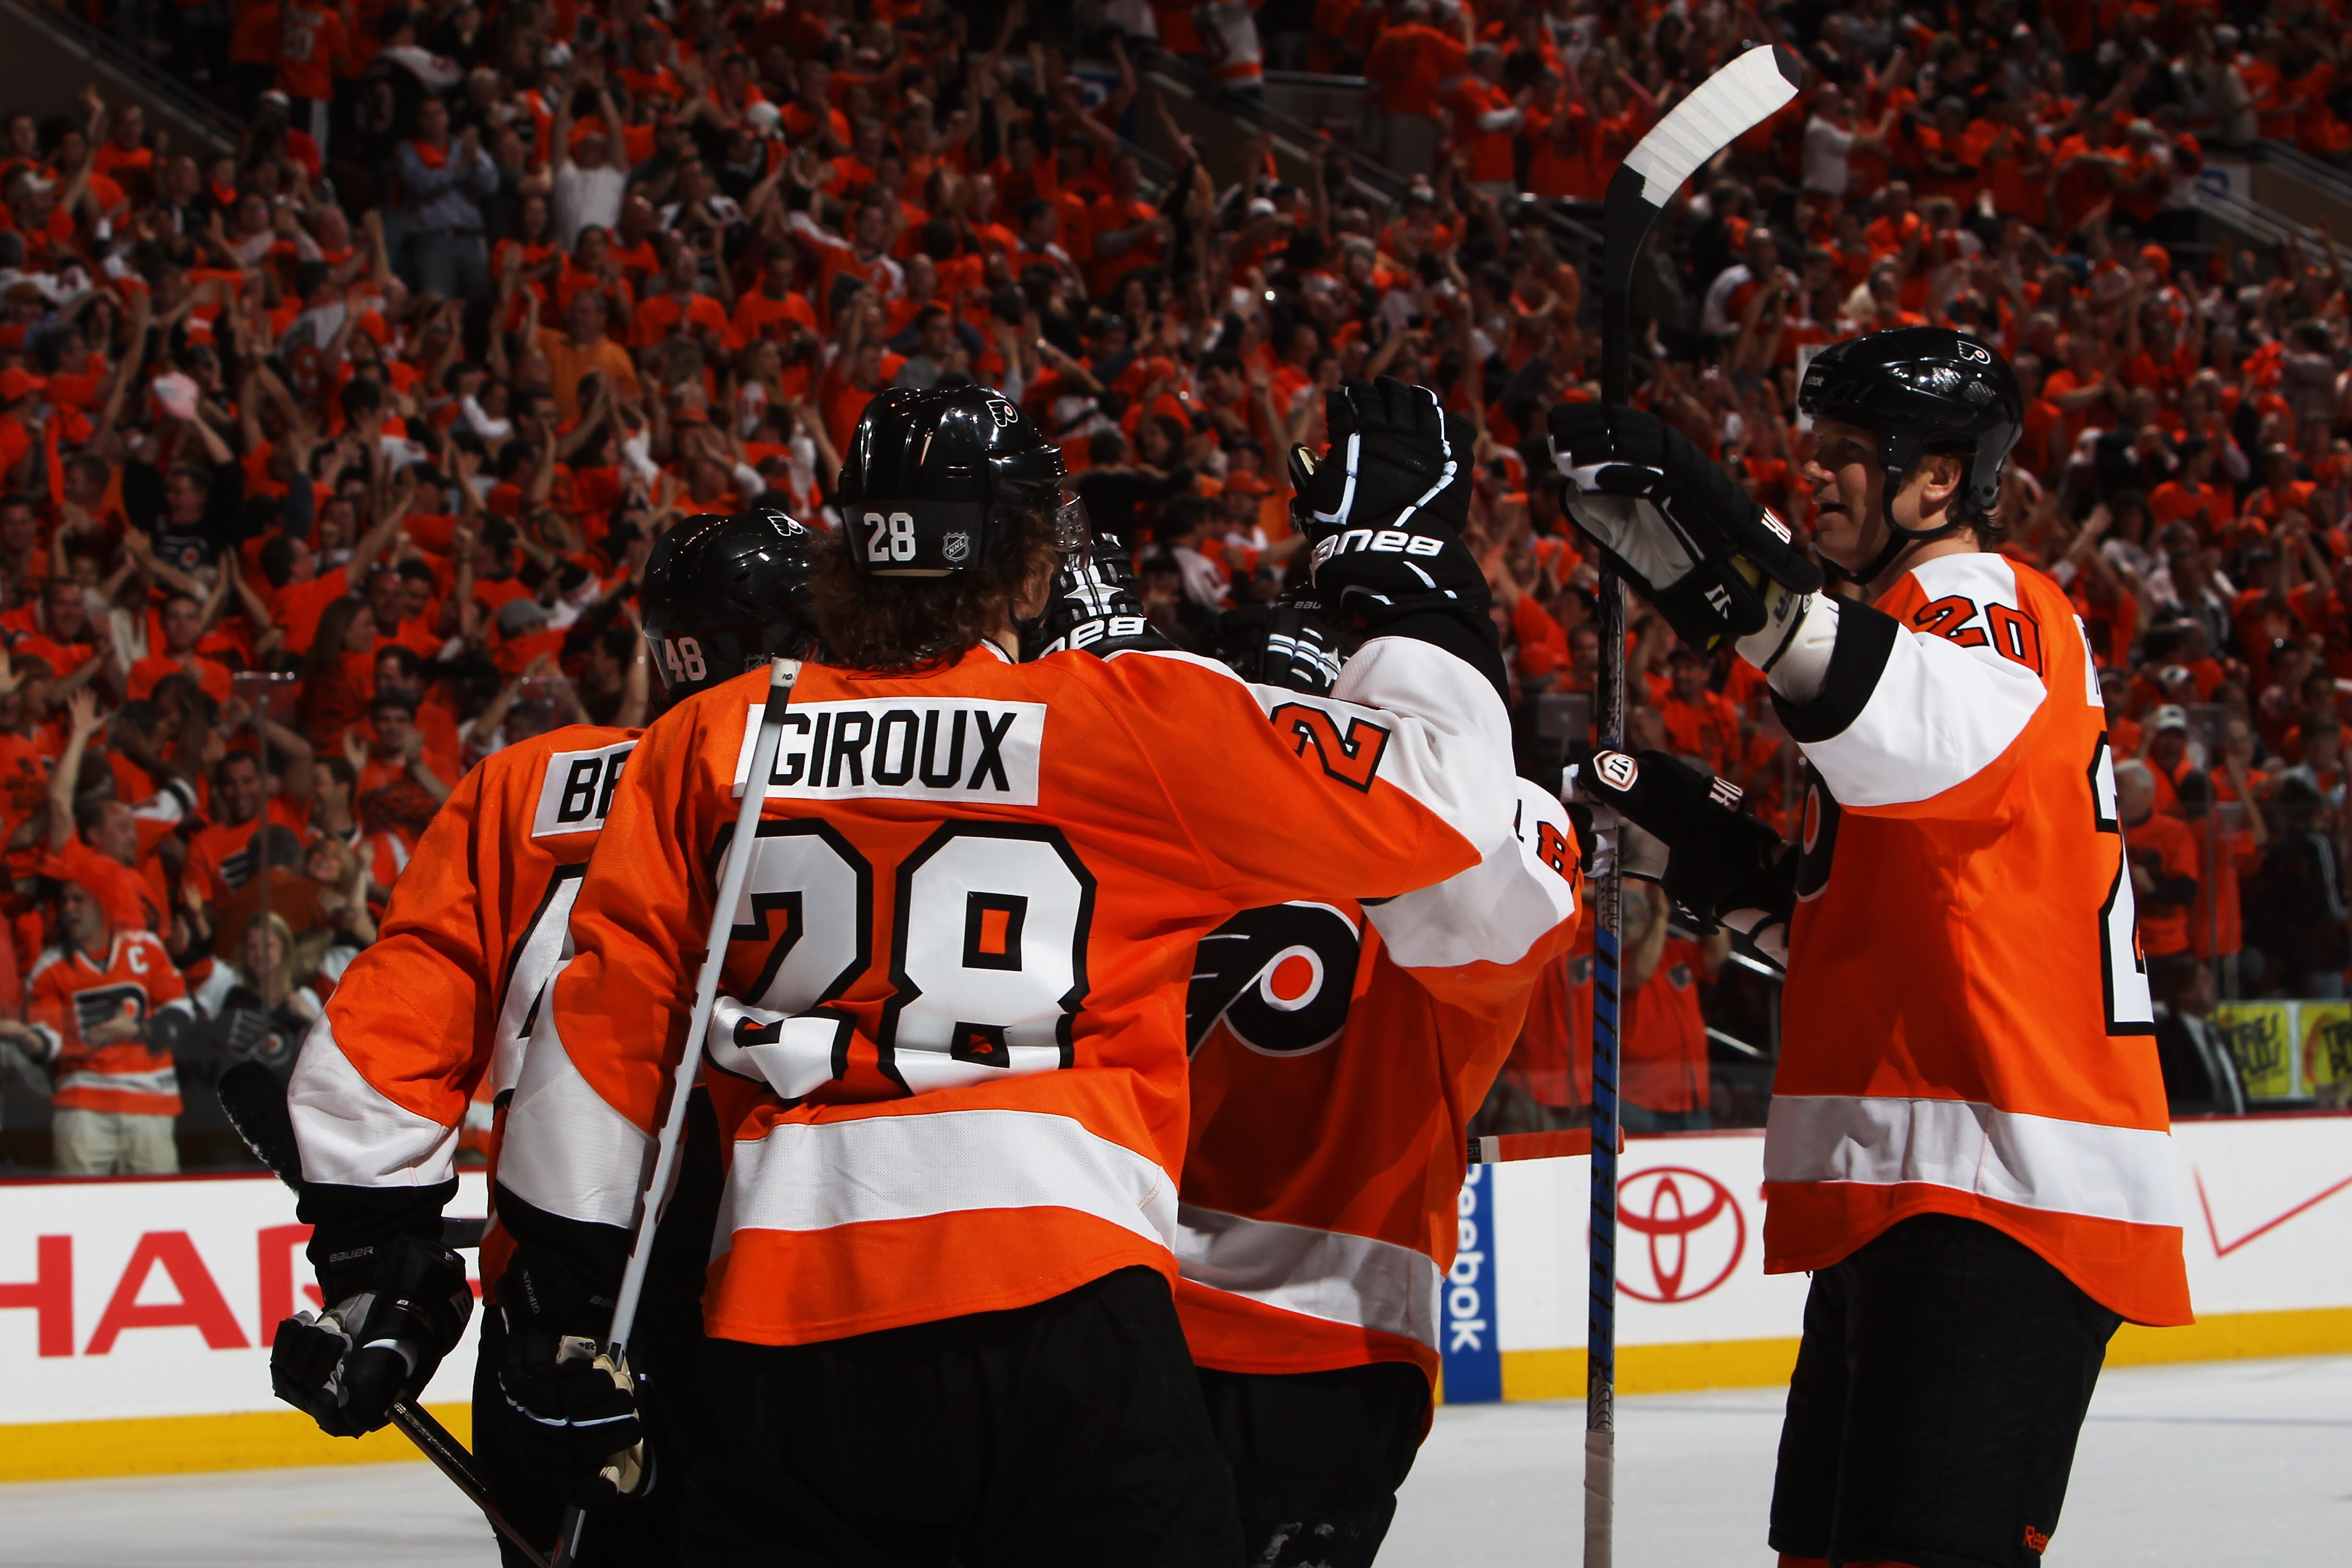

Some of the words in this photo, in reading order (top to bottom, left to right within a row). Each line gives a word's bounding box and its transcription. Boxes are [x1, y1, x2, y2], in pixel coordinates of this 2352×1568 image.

[863, 512, 916, 562] 28
[948, 539, 965, 555] NHL
[1913, 594, 2043, 677] 20
[665, 637, 707, 682] 48
[770, 710, 1017, 792] GIROUX
[127, 945, 148, 974] C
[702, 817, 1098, 1100] 28
[522, 1269, 540, 1314] GIROUX
